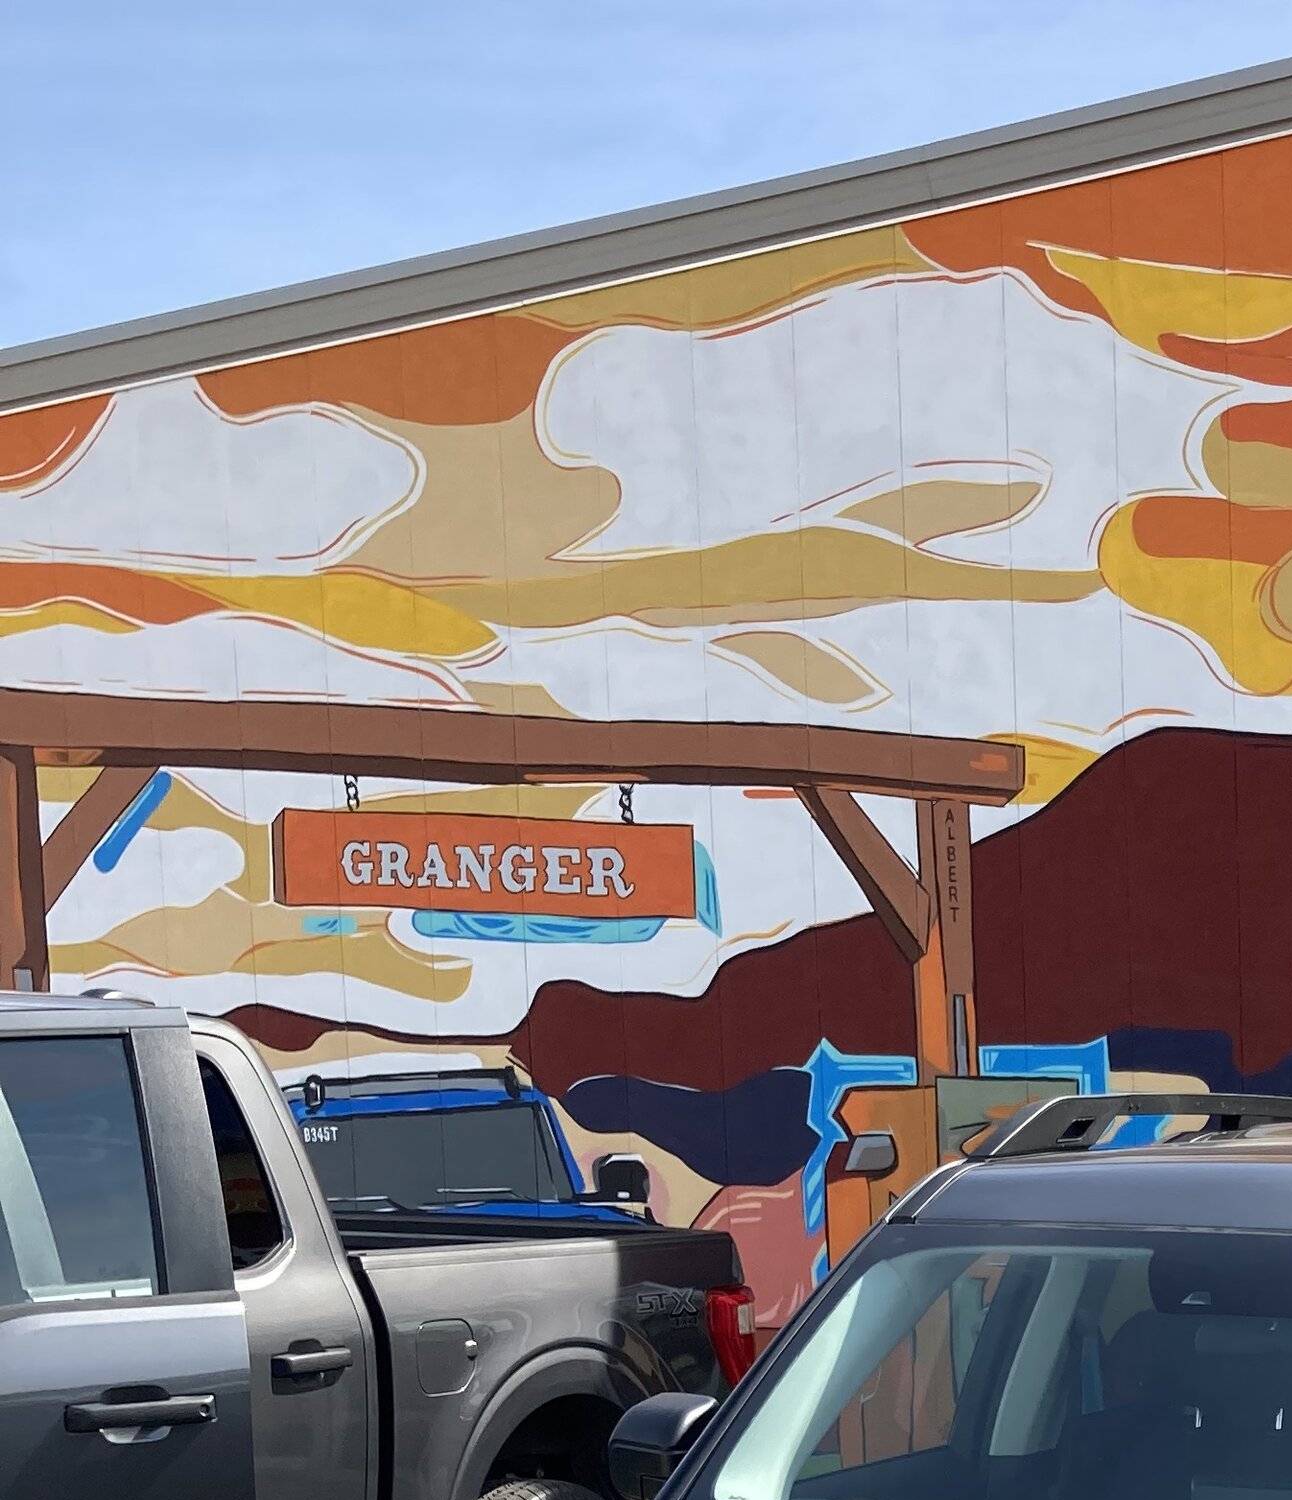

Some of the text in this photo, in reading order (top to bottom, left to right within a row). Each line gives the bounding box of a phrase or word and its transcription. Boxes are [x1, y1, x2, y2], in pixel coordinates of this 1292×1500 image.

[341, 841, 635, 899] GRANGER
[945, 808, 960, 922] ALBERT
[637, 1286, 699, 1316] STX
